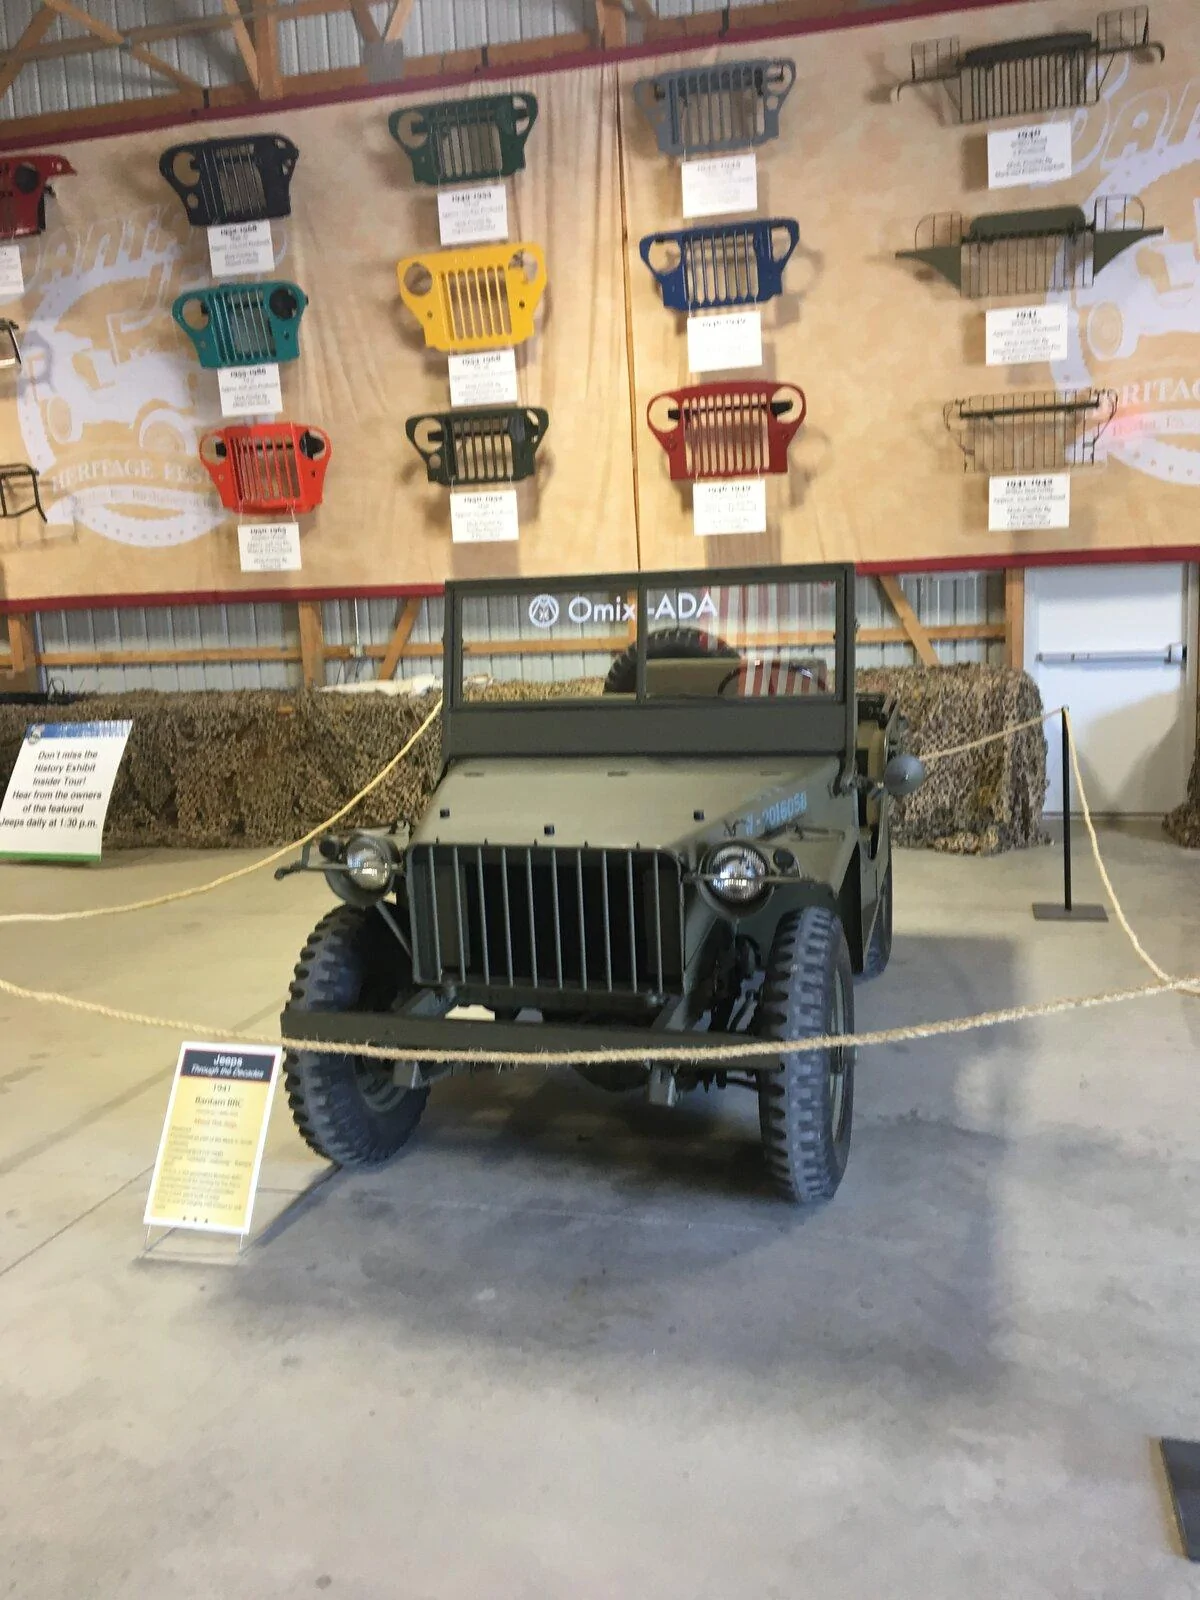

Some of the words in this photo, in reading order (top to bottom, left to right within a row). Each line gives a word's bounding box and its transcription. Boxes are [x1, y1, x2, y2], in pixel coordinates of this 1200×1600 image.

[62, 750, 82, 759] miss
[84, 749, 98, 759] the
[34, 764, 64, 775] History
[66, 763, 96, 773] Exhibit
[32, 777, 61, 786] Insider
[64, 777, 87, 786] Tour!
[12, 791, 31, 799] Hear
[33, 790, 53, 799] from
[54, 790, 69, 799] the
[70, 791, 102, 799] owners
[22, 804, 33, 813] of
[33, 804, 47, 813] the
[49, 803, 85, 813] featured
[26, 816, 47, 828] daily
[48, 817, 58, 827] at
[213, 1053, 243, 1068] Jeeps
[191, 1063, 220, 1076] Through
[220, 1066, 232, 1076] the
[213, 1083, 231, 1093] 1941
[194, 1096, 226, 1105] Bantam
